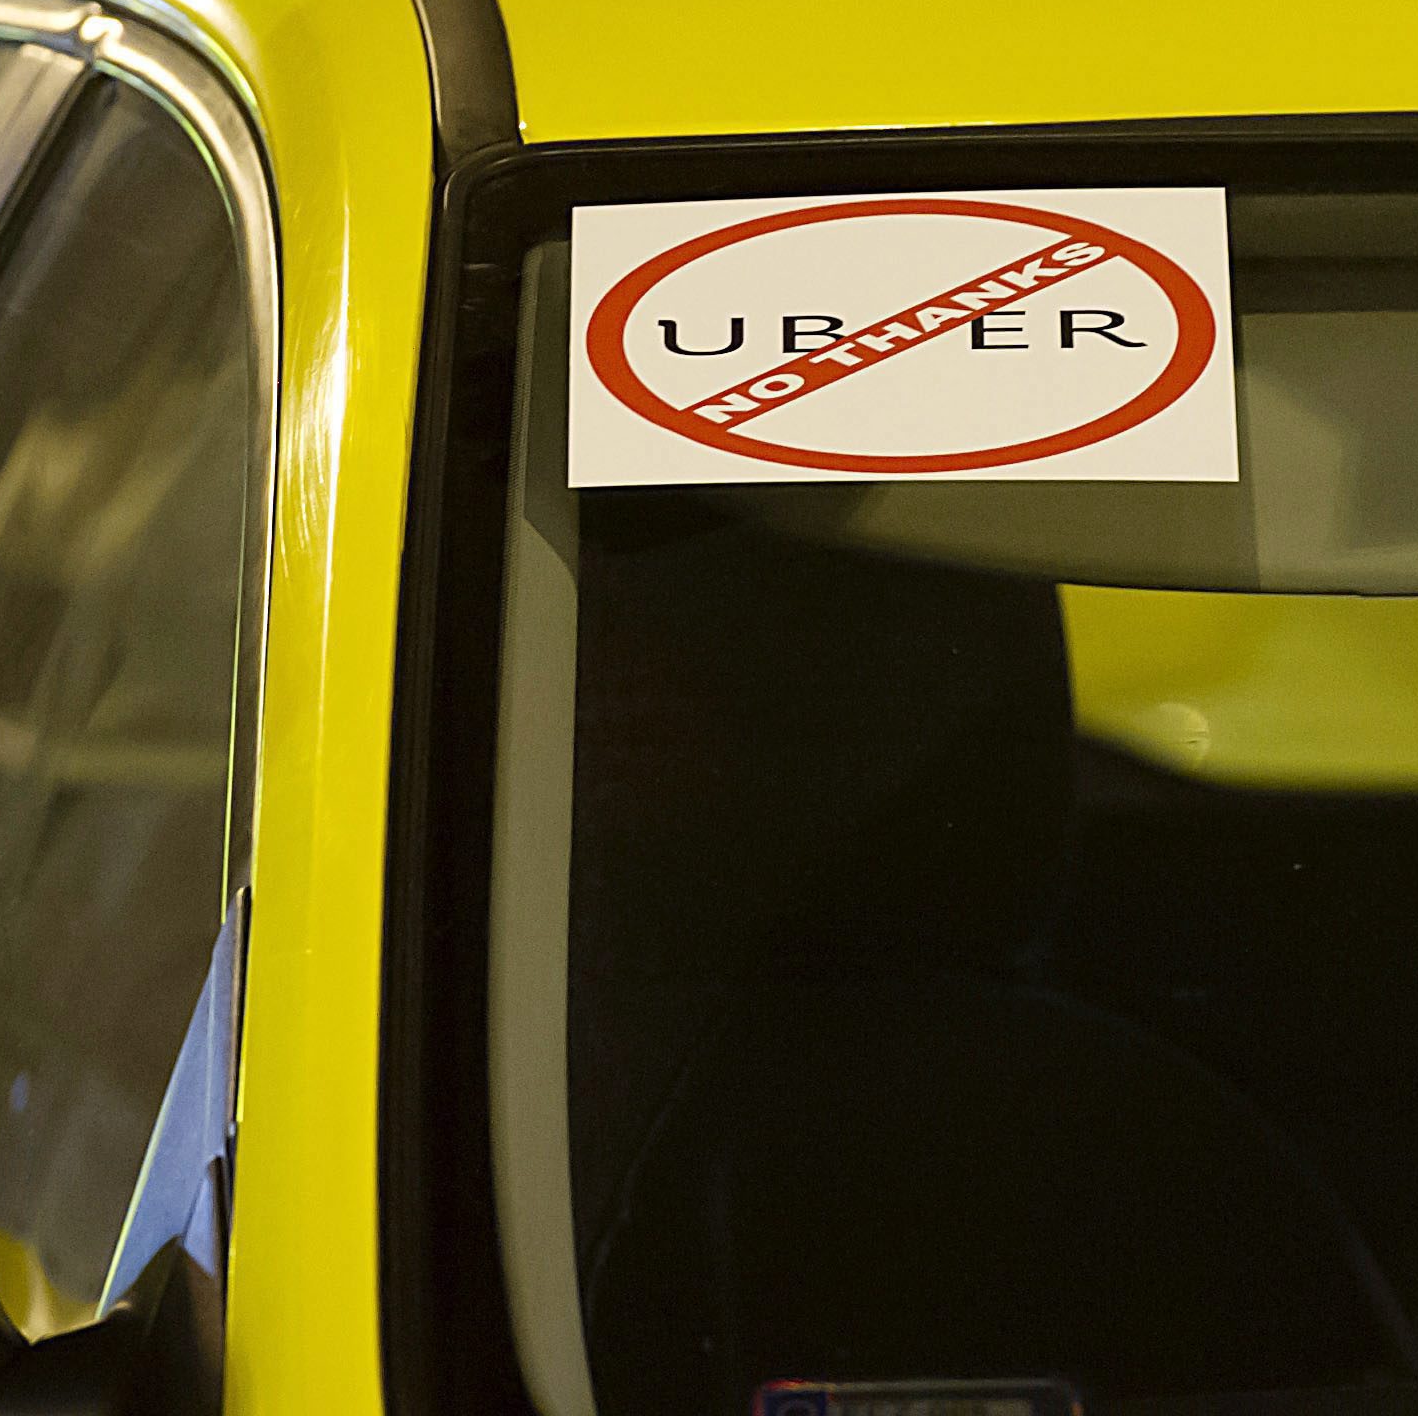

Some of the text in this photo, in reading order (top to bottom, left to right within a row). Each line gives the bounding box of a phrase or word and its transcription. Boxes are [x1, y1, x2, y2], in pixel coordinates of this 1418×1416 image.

[657, 309, 1148, 356] UBER
[692, 240, 1106, 425] NO THANKS
